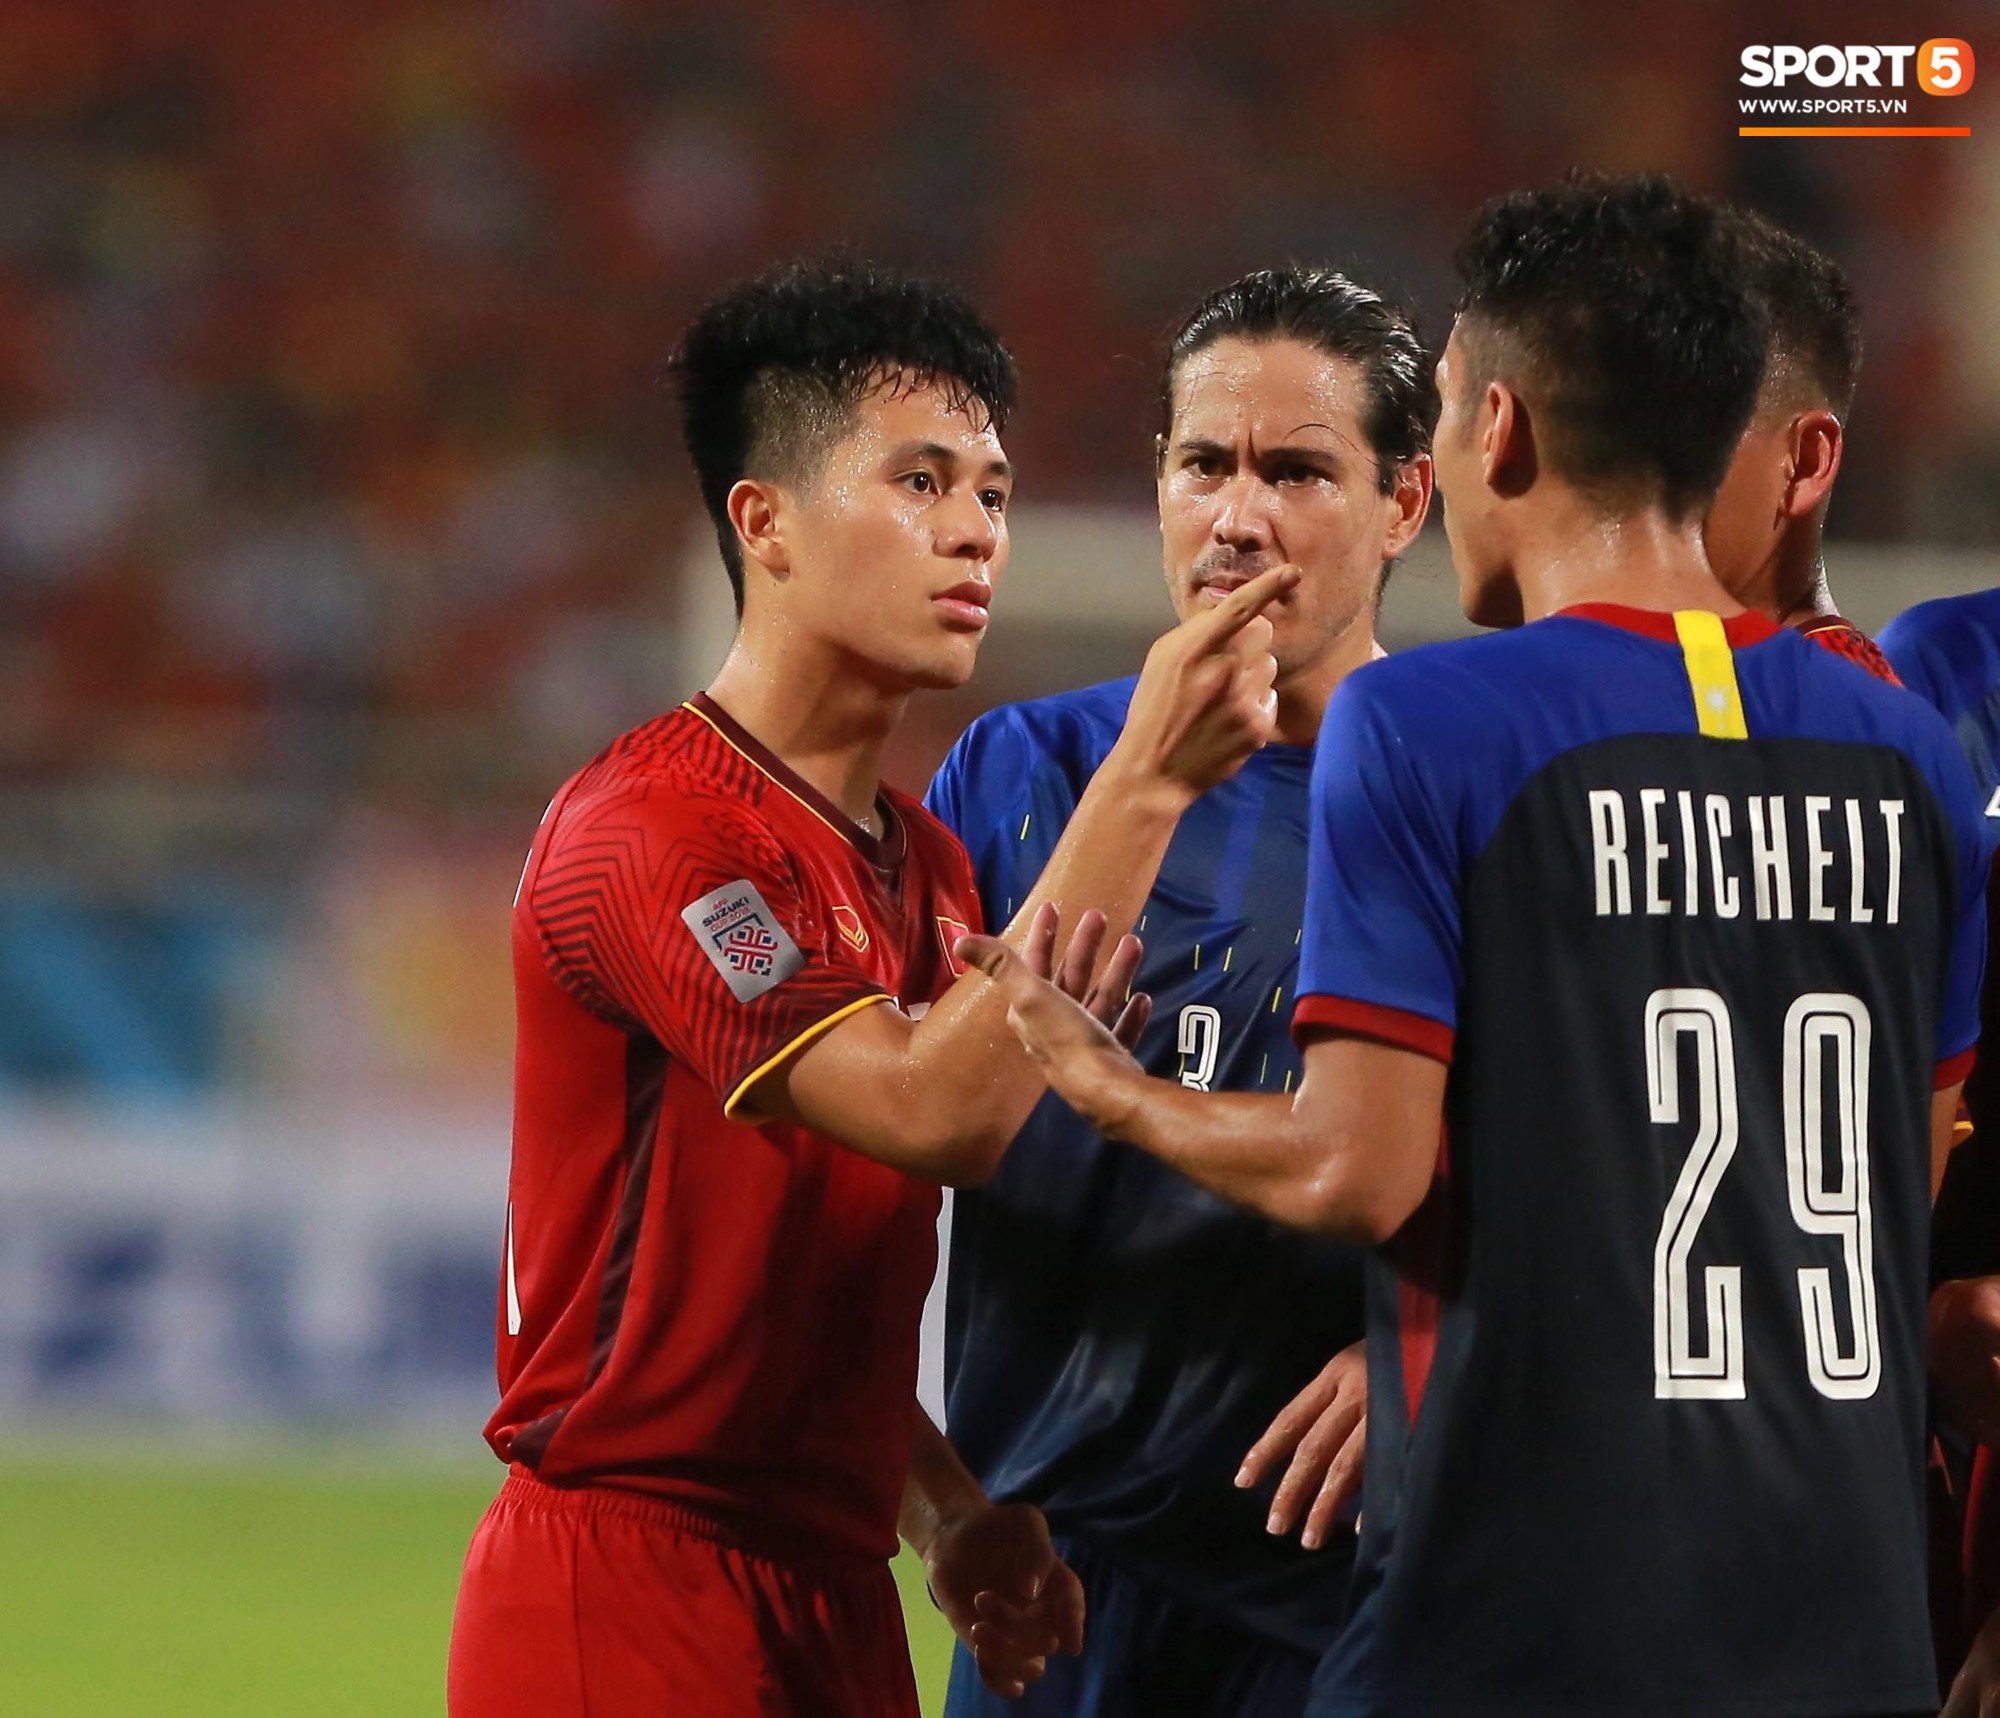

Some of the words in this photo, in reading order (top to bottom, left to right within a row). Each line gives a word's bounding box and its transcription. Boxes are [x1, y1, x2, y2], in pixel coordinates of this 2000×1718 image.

[702, 896, 750, 927] SUZUKI
[1588, 788, 1905, 925] REICHELT
[1644, 987, 1881, 1400] 29
